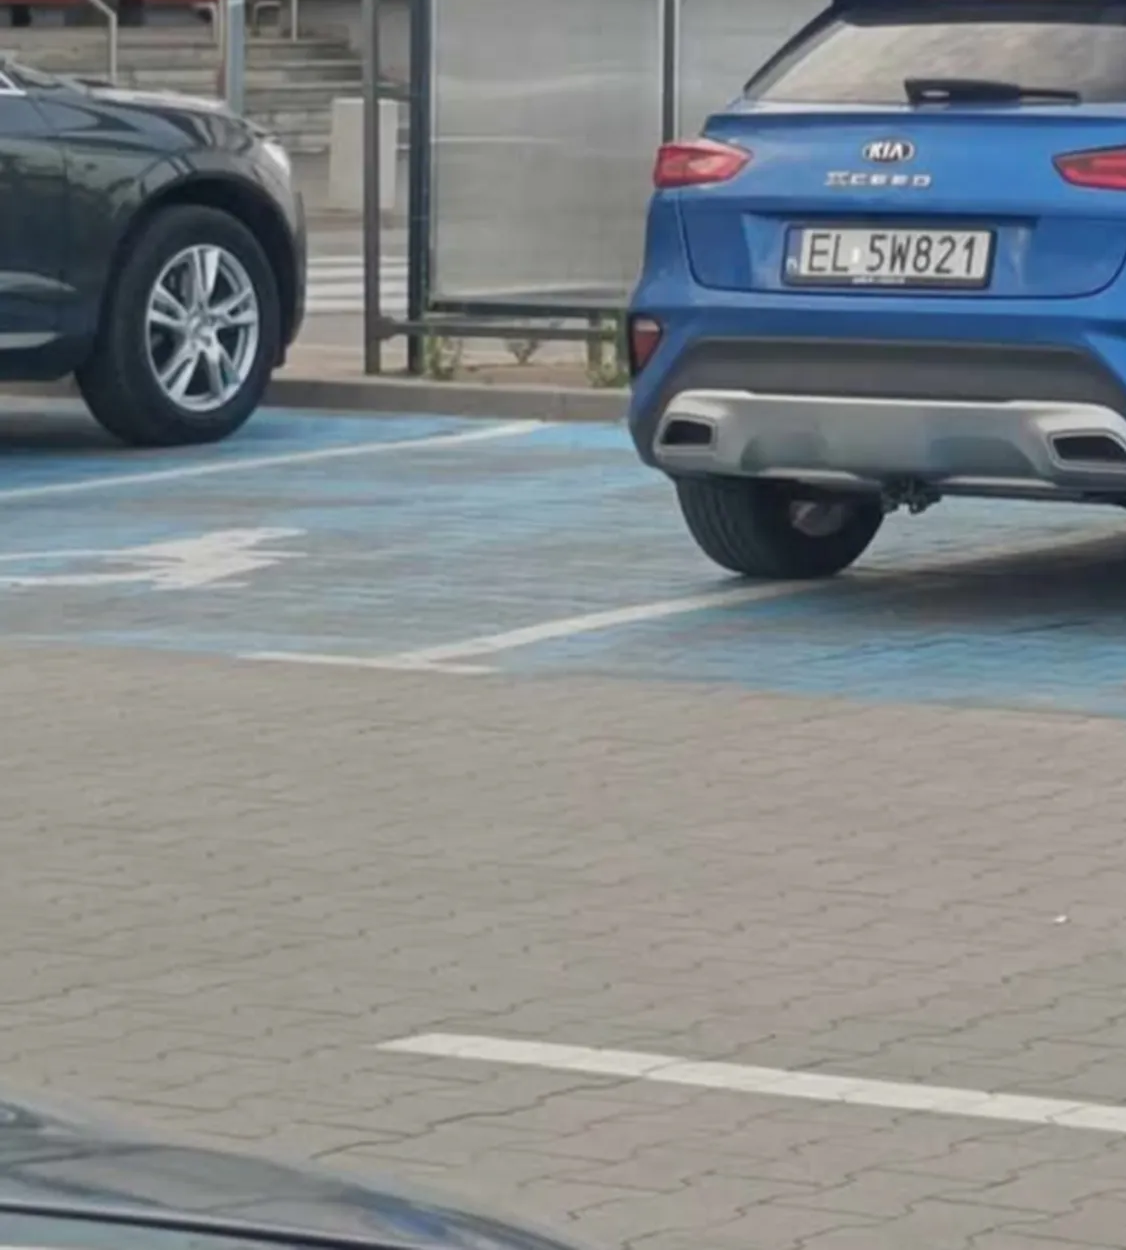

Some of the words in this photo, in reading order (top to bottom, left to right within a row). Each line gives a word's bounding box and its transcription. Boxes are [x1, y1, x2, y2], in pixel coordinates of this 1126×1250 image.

[867, 141, 906, 161] KIA
[808, 233, 850, 273] EL
[866, 234, 977, 275] 5W821
